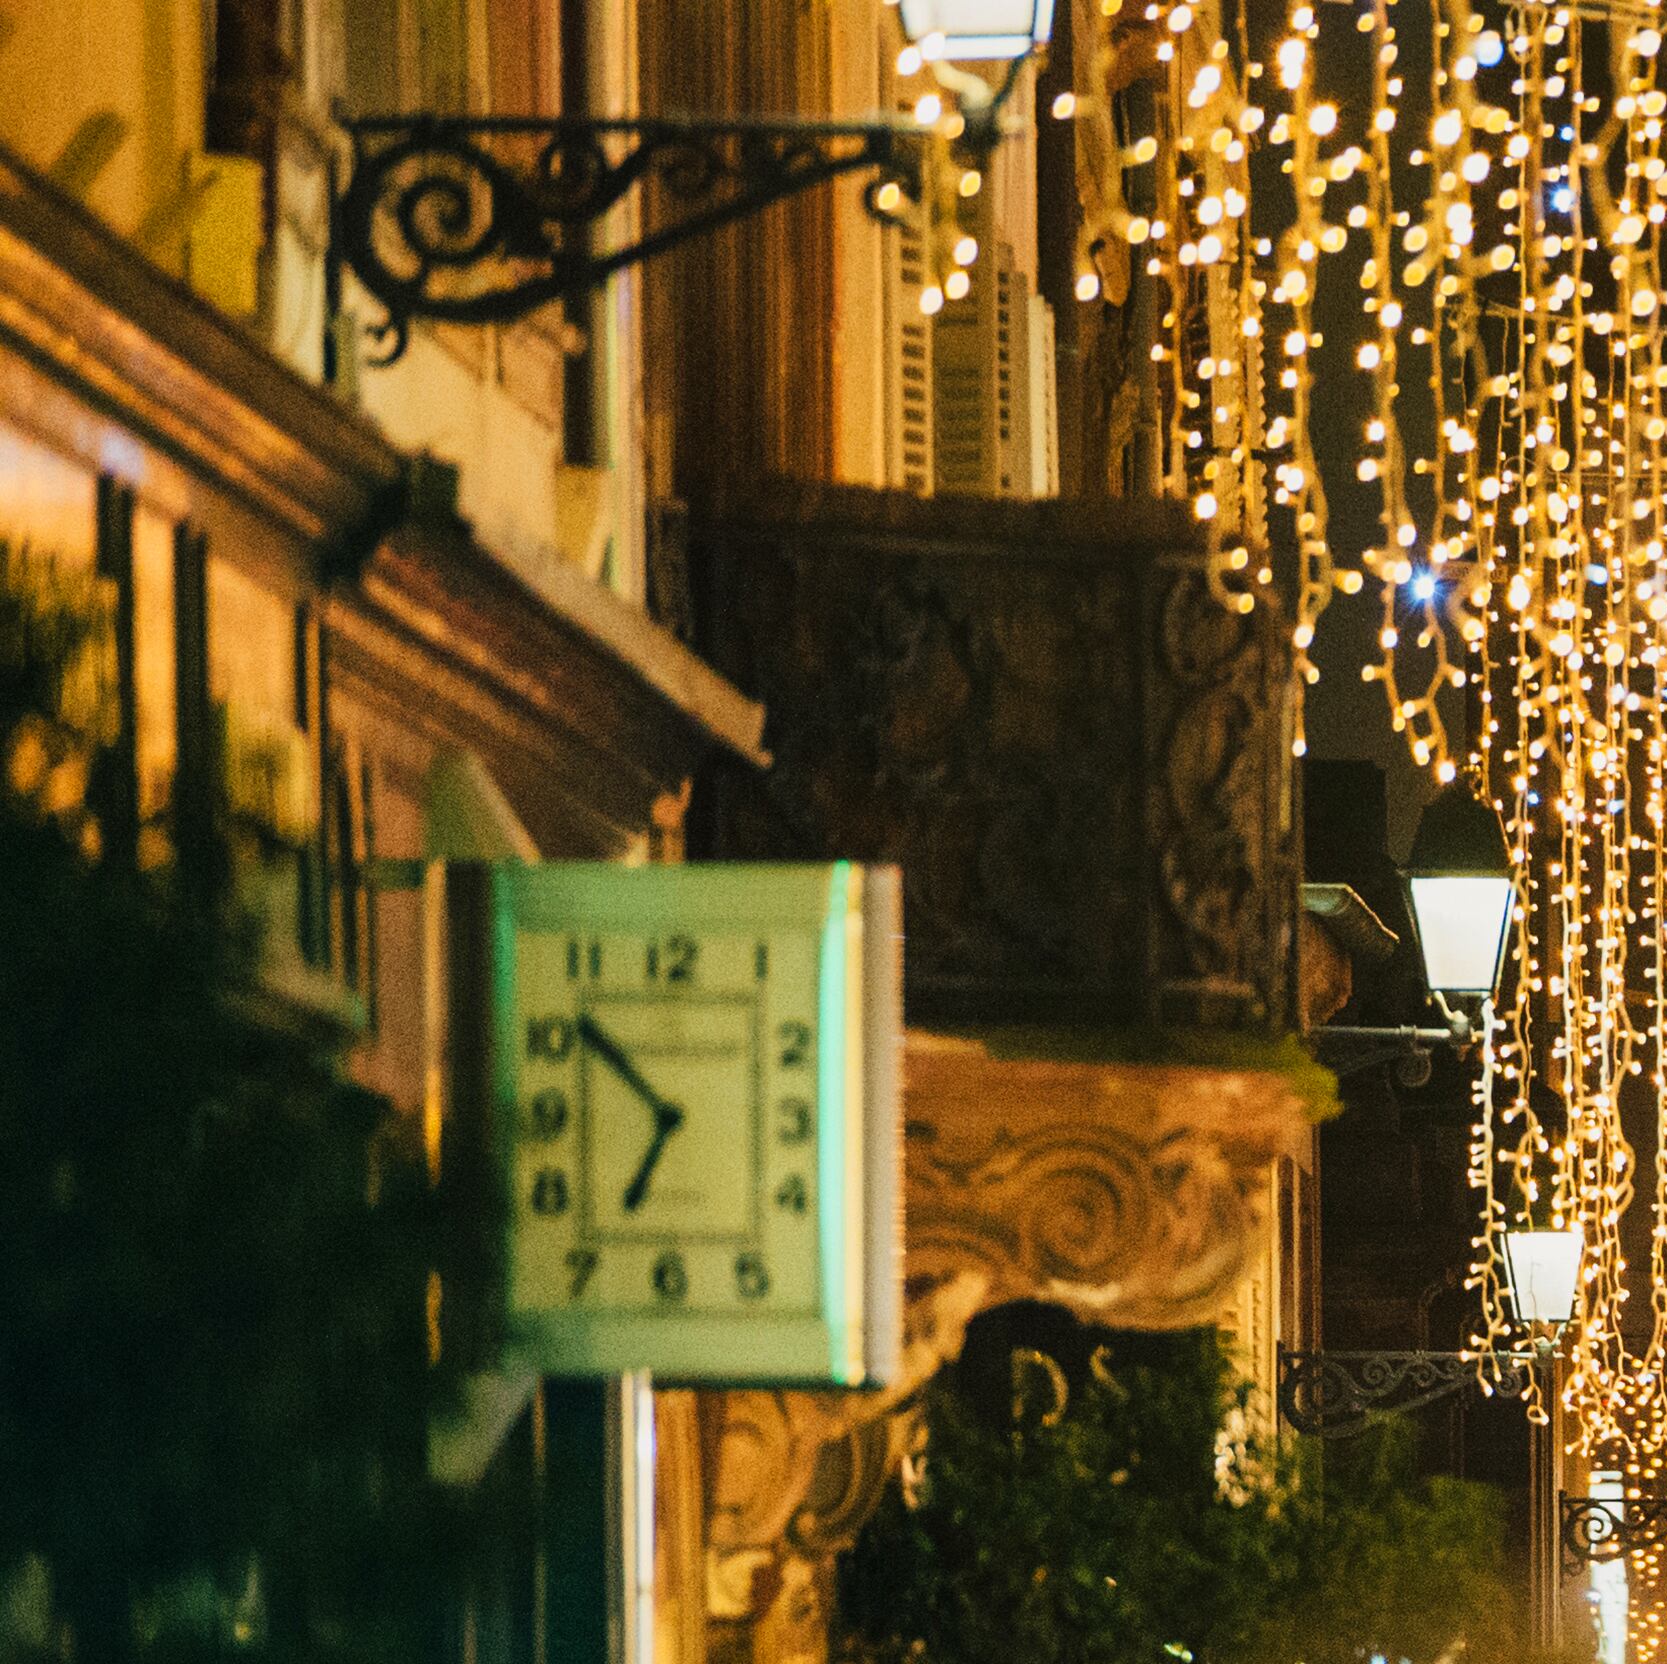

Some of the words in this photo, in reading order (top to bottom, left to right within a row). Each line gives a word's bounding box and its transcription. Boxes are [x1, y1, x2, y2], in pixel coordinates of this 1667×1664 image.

[566, 940, 603, 982] 11
[645, 936, 697, 984] 12
[754, 942, 770, 982] 1
[526, 1017, 575, 1064] 10
[777, 1020, 811, 1068] 2
[532, 1089, 569, 1140] 9
[777, 1099, 812, 1147] 3
[532, 1168, 569, 1216] 8
[775, 1172, 807, 1214] 4
[566, 1249, 602, 1299] 7
[652, 1251, 689, 1302] 6
[734, 1251, 771, 1302] 5
